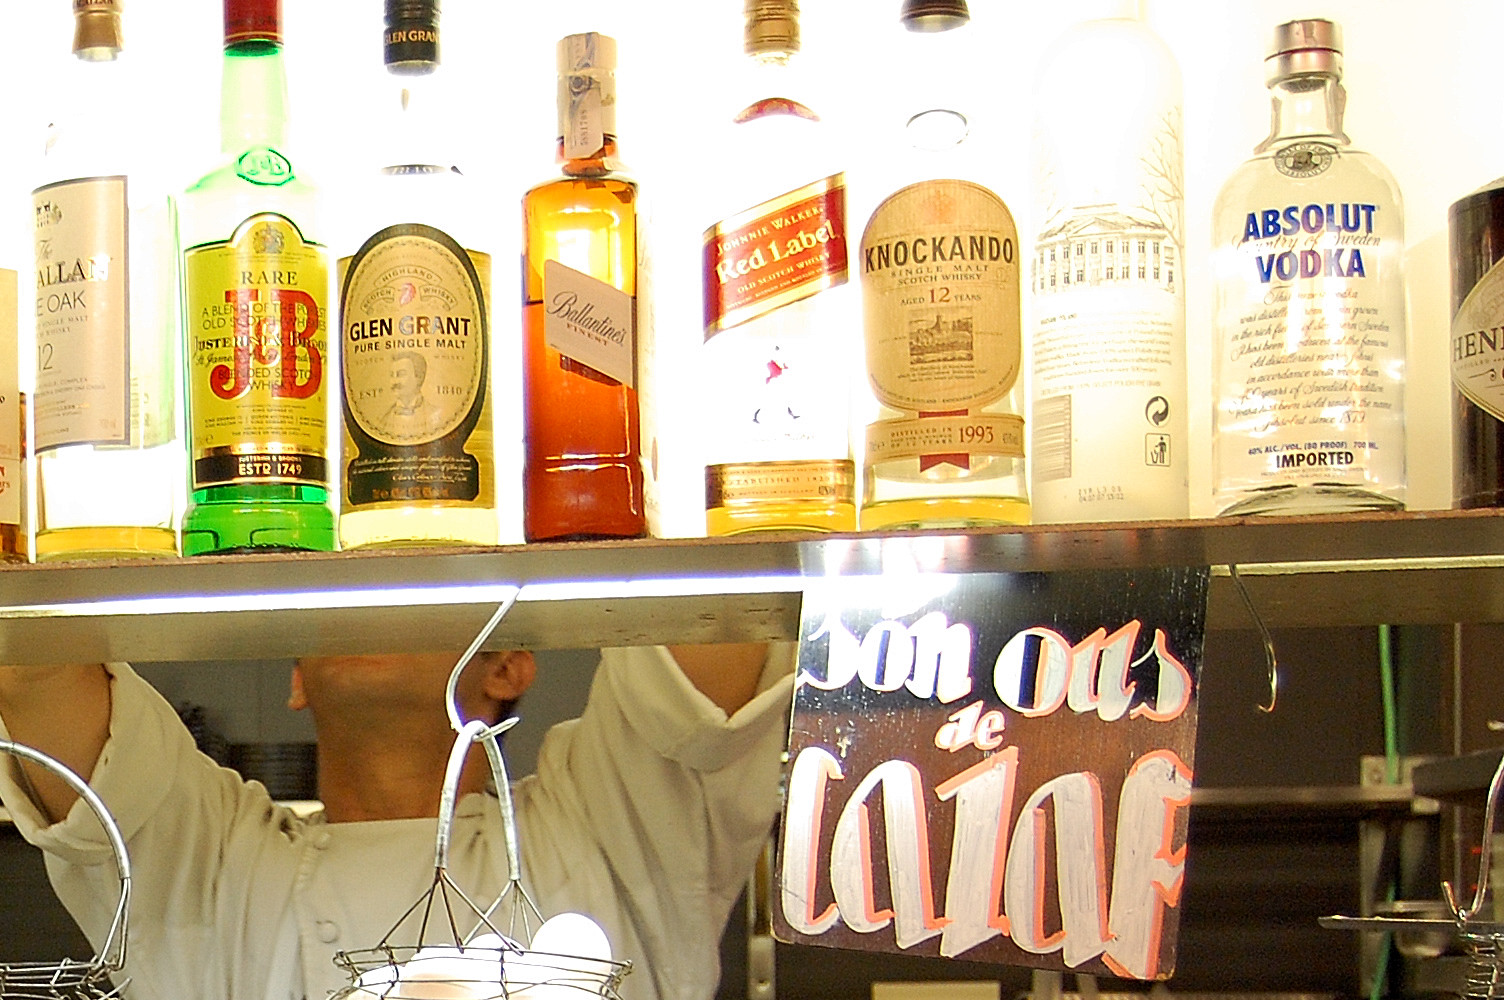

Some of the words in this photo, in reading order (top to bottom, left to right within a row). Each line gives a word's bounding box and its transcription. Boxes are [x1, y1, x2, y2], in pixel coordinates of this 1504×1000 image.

[1242, 203, 1376, 243] ABSOLUT
[716, 248, 767, 284] Red
[768, 219, 836, 262] Label
[717, 226, 771, 256] JOHNNIE
[865, 236, 1013, 273] KNOCKANDO
[1255, 248, 1366, 283] VODKA
[241, 271, 299, 285] RARE
[382, 269, 433, 282] HIGHLAND
[738, 281, 756, 294] OLD
[758, 266, 794, 285] SCOTCH
[890, 264, 943, 277] SINGLE
[953, 264, 989, 272] MALT
[897, 275, 937, 286] SCOTCH
[942, 273, 982, 282] WHISKY
[47, 289, 86, 313] OAK
[364, 290, 391, 308] SCOTCH
[423, 287, 454, 303] WHISKY
[900, 297, 925, 305] AGED
[929, 287, 951, 304] 12
[203, 317, 226, 330] OLD
[350, 318, 393, 342] GLEN
[399, 315, 471, 337] GRANT
[546, 291, 627, 344] Ballantine's
[354, 342, 381, 354] PURE
[385, 339, 431, 350] SINGLE
[436, 339, 466, 348] MALT
[1453, 326, 1504, 362] HEN
[37, 343, 53, 371] 12
[436, 385, 463, 396] 1840
[958, 425, 994, 444] 1993
[277, 464, 302, 475] 1749
[1276, 451, 1354, 468] IMPORTED
[934, 699, 1005, 753] de
